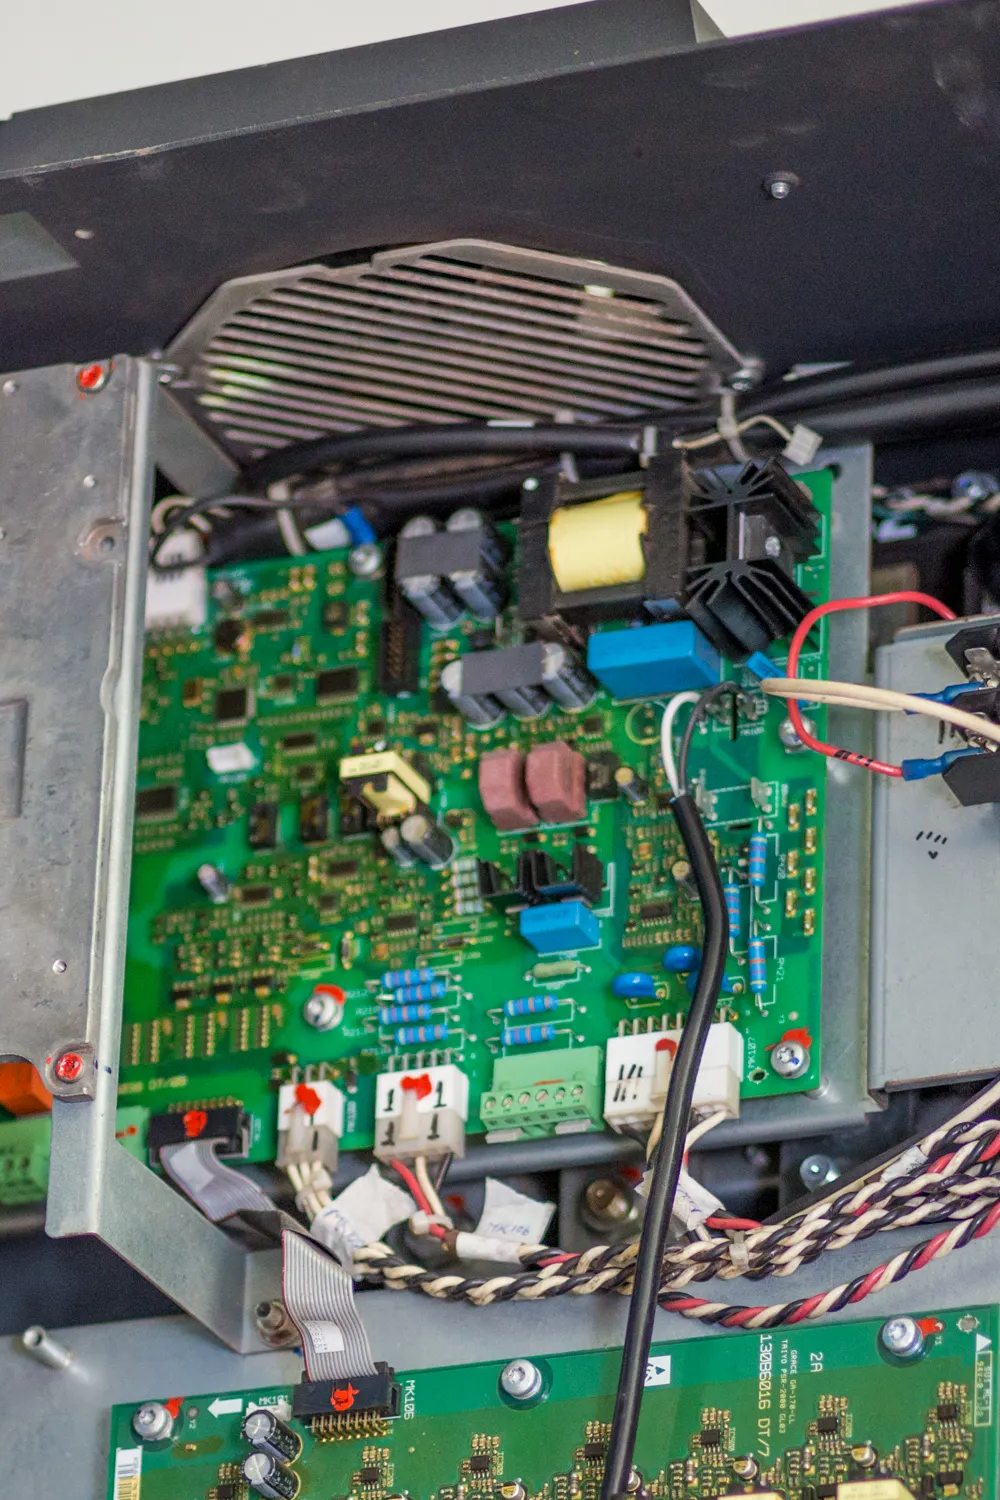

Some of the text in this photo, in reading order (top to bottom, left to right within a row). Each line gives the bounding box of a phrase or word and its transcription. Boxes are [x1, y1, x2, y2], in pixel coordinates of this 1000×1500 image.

[758, 1333, 773, 1410] 130B6016
[810, 1352, 824, 1373] 2A
[404, 1380, 416, 1420] MK106
